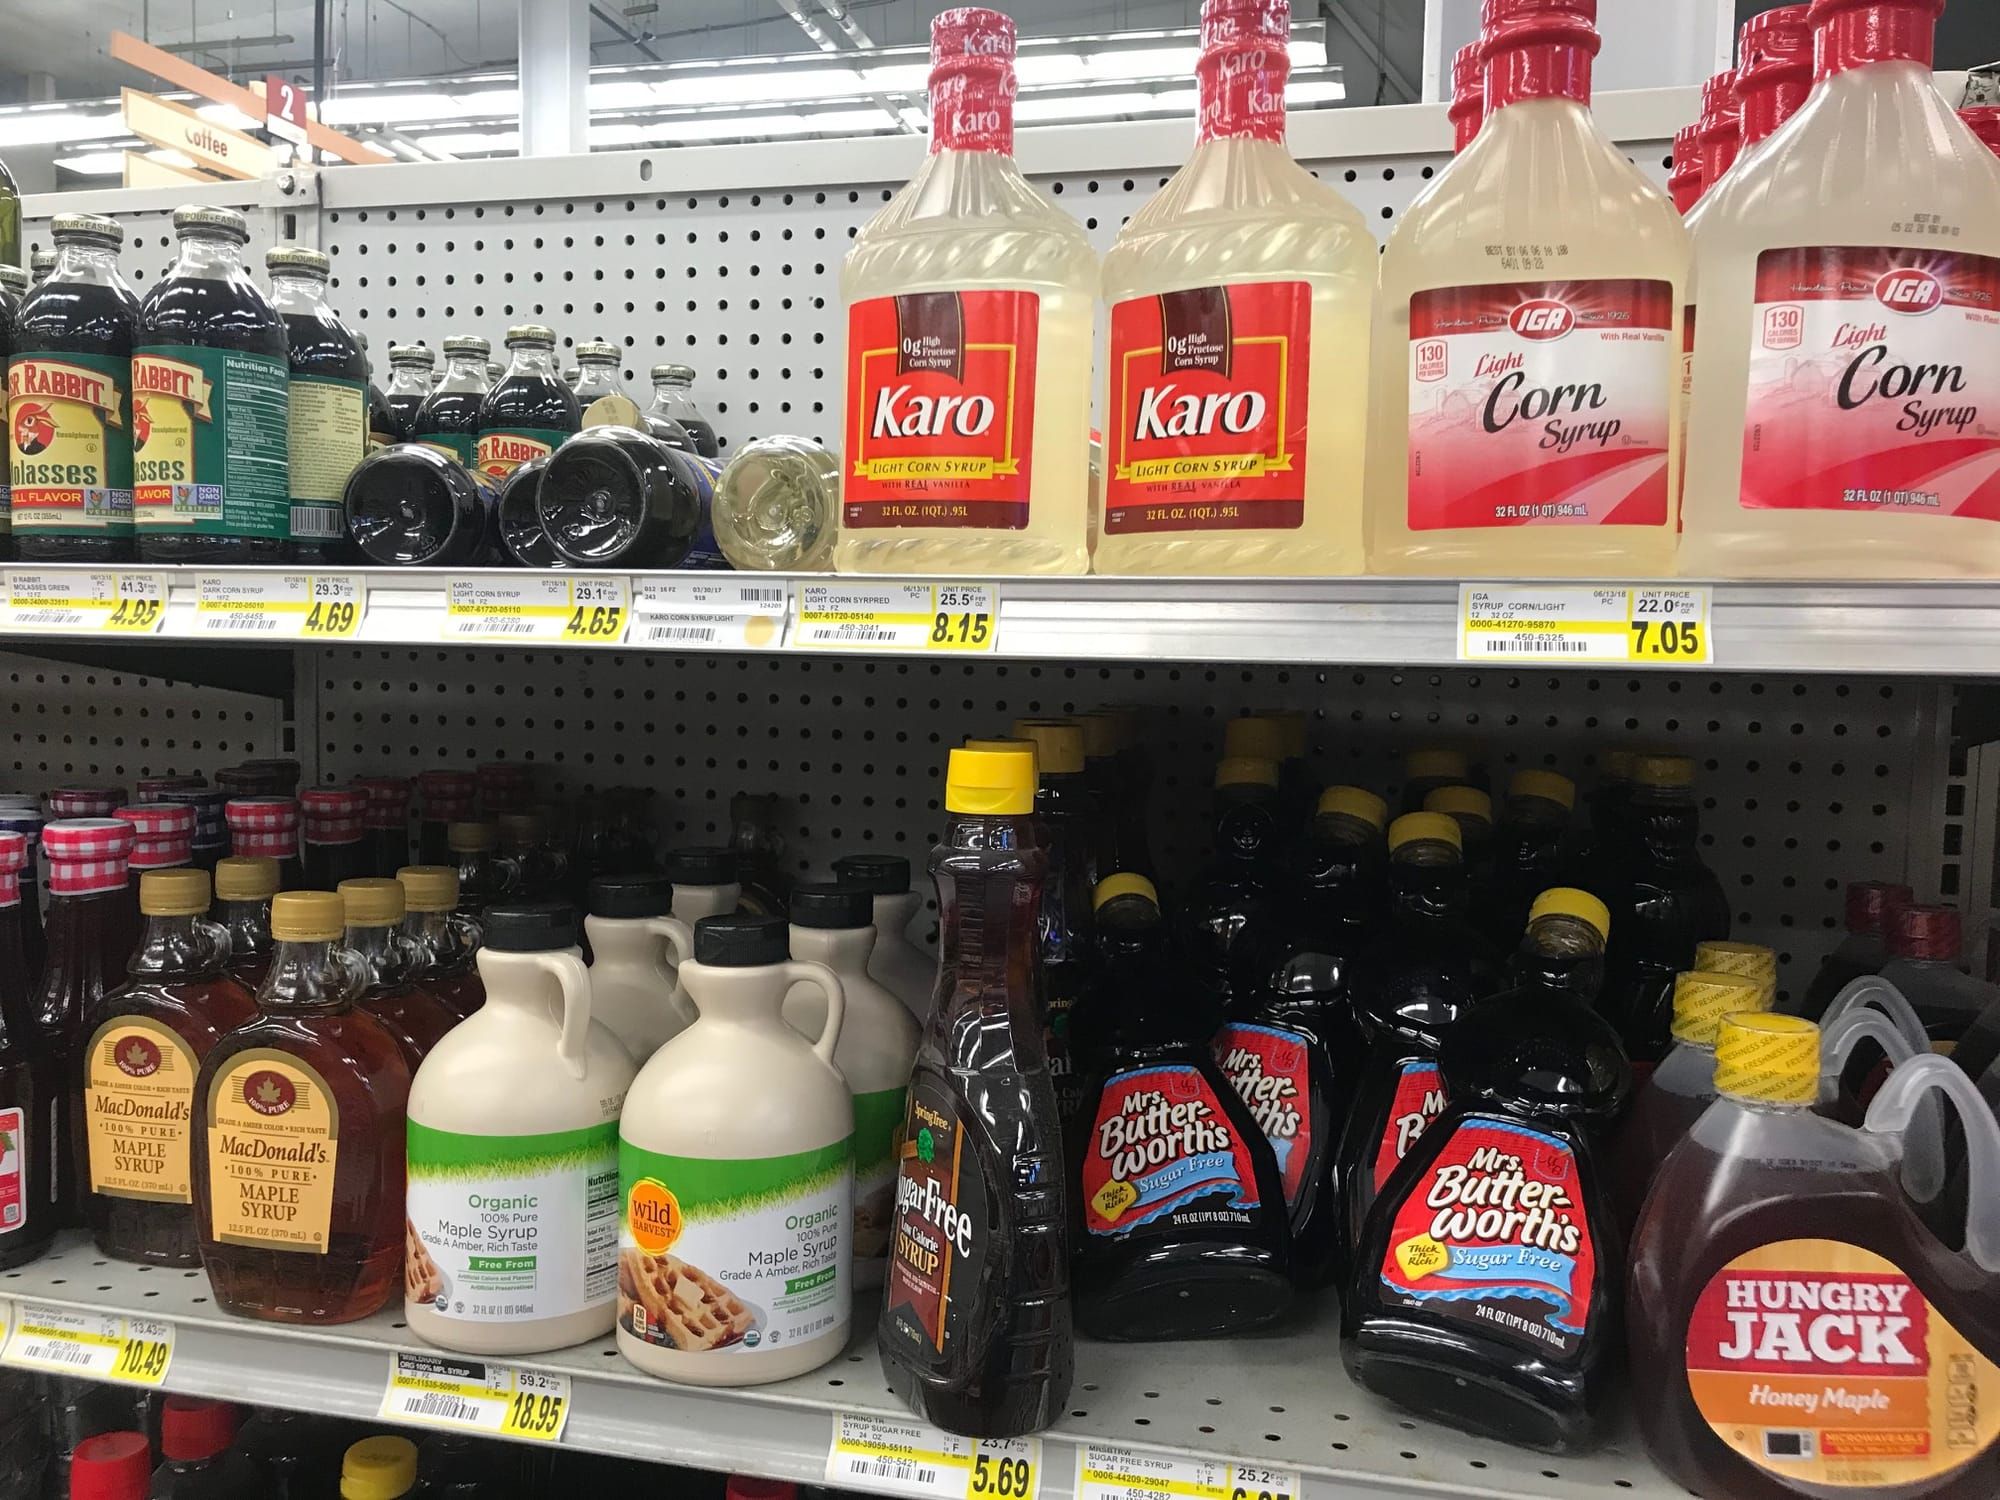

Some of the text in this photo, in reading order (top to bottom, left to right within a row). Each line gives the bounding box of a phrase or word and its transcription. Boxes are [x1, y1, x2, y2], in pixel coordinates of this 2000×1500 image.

[964, 30, 1014, 56] Karo
[1219, 49, 1265, 80] Karo
[280, 85, 294, 121] 2
[1248, 88, 1286, 114] Karo
[953, 109, 999, 135] Karo
[1883, 279, 1934, 303] IGA
[1517, 309, 1566, 331] IGA
[1770, 311, 1798, 328] 130
[903, 337, 921, 356] 0g
[922, 336, 941, 347] High
[1168, 336, 1187, 356] 0g
[1188, 333, 1207, 345] High
[1600, 333, 1640, 342] With Real
[1831, 323, 1888, 350] Light
[922, 347, 957, 357] Fructose
[1174, 354, 1219, 367] Corn Syrup
[1188, 344, 1224, 355] Fructose
[1420, 345, 1443, 361] 130
[227, 359, 267, 372] Nutrition
[909, 357, 952, 369] Corn Syrup
[1474, 352, 1525, 378] Light
[25, 364, 105, 404] RABBIT
[134, 360, 194, 398] RABBIT
[1837, 345, 1967, 410] Corn
[870, 385, 995, 439] Karo
[1134, 384, 1266, 441] Karo
[1483, 371, 1608, 434] Corn
[1895, 401, 1977, 437] Syrup
[1539, 419, 1621, 453] Syrup
[872, 460, 987, 474] LIGHT CORN SYRUP
[1136, 459, 1258, 477] LIGHT CORN SYRUP
[29, 493, 82, 503] FLAVOR
[136, 489, 171, 499] FLAVOR
[1557, 505, 1573, 517] 946
[853, 597, 890, 605] SYRPRED
[1471, 602, 1566, 611] SYRUP CORN/LIGHT
[1472, 590, 1626, 601] IGA 06/13/18
[1664, 591, 1690, 599] PRICE
[110, 599, 160, 626] 4.95
[306, 601, 354, 632] 4.69
[567, 606, 620, 635] 4.65
[804, 612, 874, 620] 0007-61720-05140
[932, 612, 988, 644] 8.15
[1470, 620, 1556, 629] 0000-41270-95870
[1514, 633, 1564, 641] 450-6325
[1631, 621, 1698, 654] 7.05
[1759, 1034, 1780, 1049] SEAL
[1744, 1047, 1788, 1070] FRESHNESS
[94, 1094, 190, 1121] MacDonald's
[1122, 1090, 1165, 1115] Mrs.
[1099, 1099, 1213, 1158] Butter-
[112, 1138, 167, 1159] MAPLE
[219, 1134, 327, 1164] MacDonald's
[1111, 1121, 1230, 1181] worth's
[1467, 1147, 1523, 1173] Mrs.
[114, 1155, 165, 1175] SYRUP
[1139, 1156, 1224, 1192] Sugar Free
[239, 1182, 300, 1205] MAPLE
[1427, 1165, 1572, 1210] Butter-
[241, 1201, 298, 1222] SYRUP
[468, 1194, 539, 1212] Organic
[633, 1200, 671, 1226] wild
[480, 1212, 539, 1223] 100% Pure
[784, 1202, 839, 1231] Organic
[897, 1173, 972, 1259] ugarFree
[438, 1219, 538, 1242] Maple Syrup
[633, 1219, 672, 1239] HARVEST
[912, 1224, 939, 1253] Calorie
[1430, 1206, 1580, 1254] worth's
[451, 1240, 538, 1253] Amber, Rich Taste
[748, 1234, 838, 1268] Maple Syrup
[899, 1231, 939, 1276] SYRUP
[1407, 1244, 1440, 1254] Thick
[478, 1259, 534, 1269] Free From
[719, 1258, 820, 1281] Grade Amber, Rich
[1407, 1254, 1439, 1266] Rich!
[1453, 1248, 1562, 1272] Sugar Free
[794, 1277, 815, 1291] Free
[1726, 1280, 1911, 1313] HUNGRY
[1719, 1312, 1916, 1364] JACK
[120, 1339, 167, 1377] 10.49
[400, 1360, 415, 1370] ORG
[447, 1367, 470, 1377] SYRUP
[1749, 1384, 1890, 1414] Honey Maple
[511, 1391, 563, 1433] 18.95
[842, 1414, 873, 1423] SPRING
[843, 1422, 921, 1438] SYRUP SUGAR FREE
[841, 1437, 913, 1454] 0000-39059-55112
[876, 1456, 918, 1468] 450-5421
[1088, 1453, 1173, 1470] SUGAR FREE SYRUP
[972, 1454, 1030, 1498] 5.69
[1092, 1470, 1171, 1488] 0006-44209-29047
